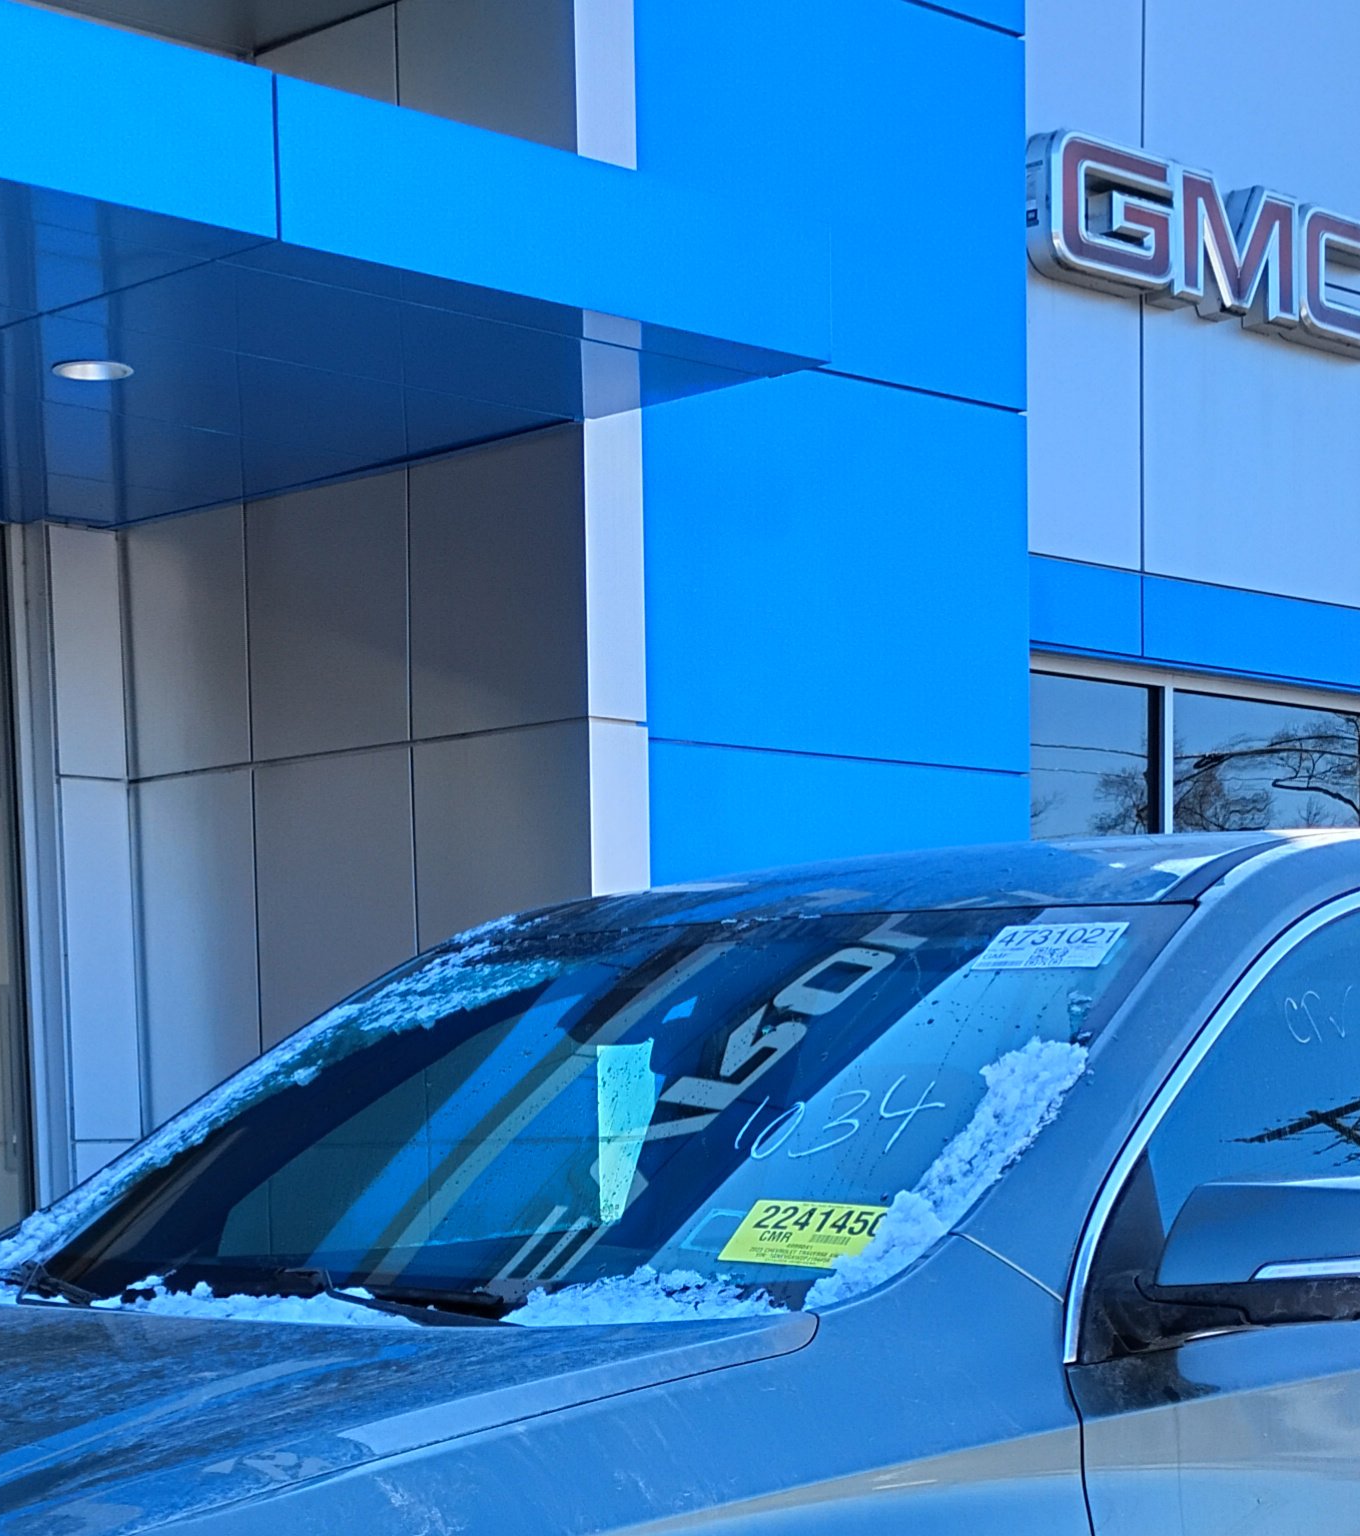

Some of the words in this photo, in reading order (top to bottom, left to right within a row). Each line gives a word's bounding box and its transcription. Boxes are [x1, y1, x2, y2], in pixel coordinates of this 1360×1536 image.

[998, 927, 1121, 947] 4731021
[734, 1073, 945, 1161] 1034
[759, 1230, 793, 1243] CMR
